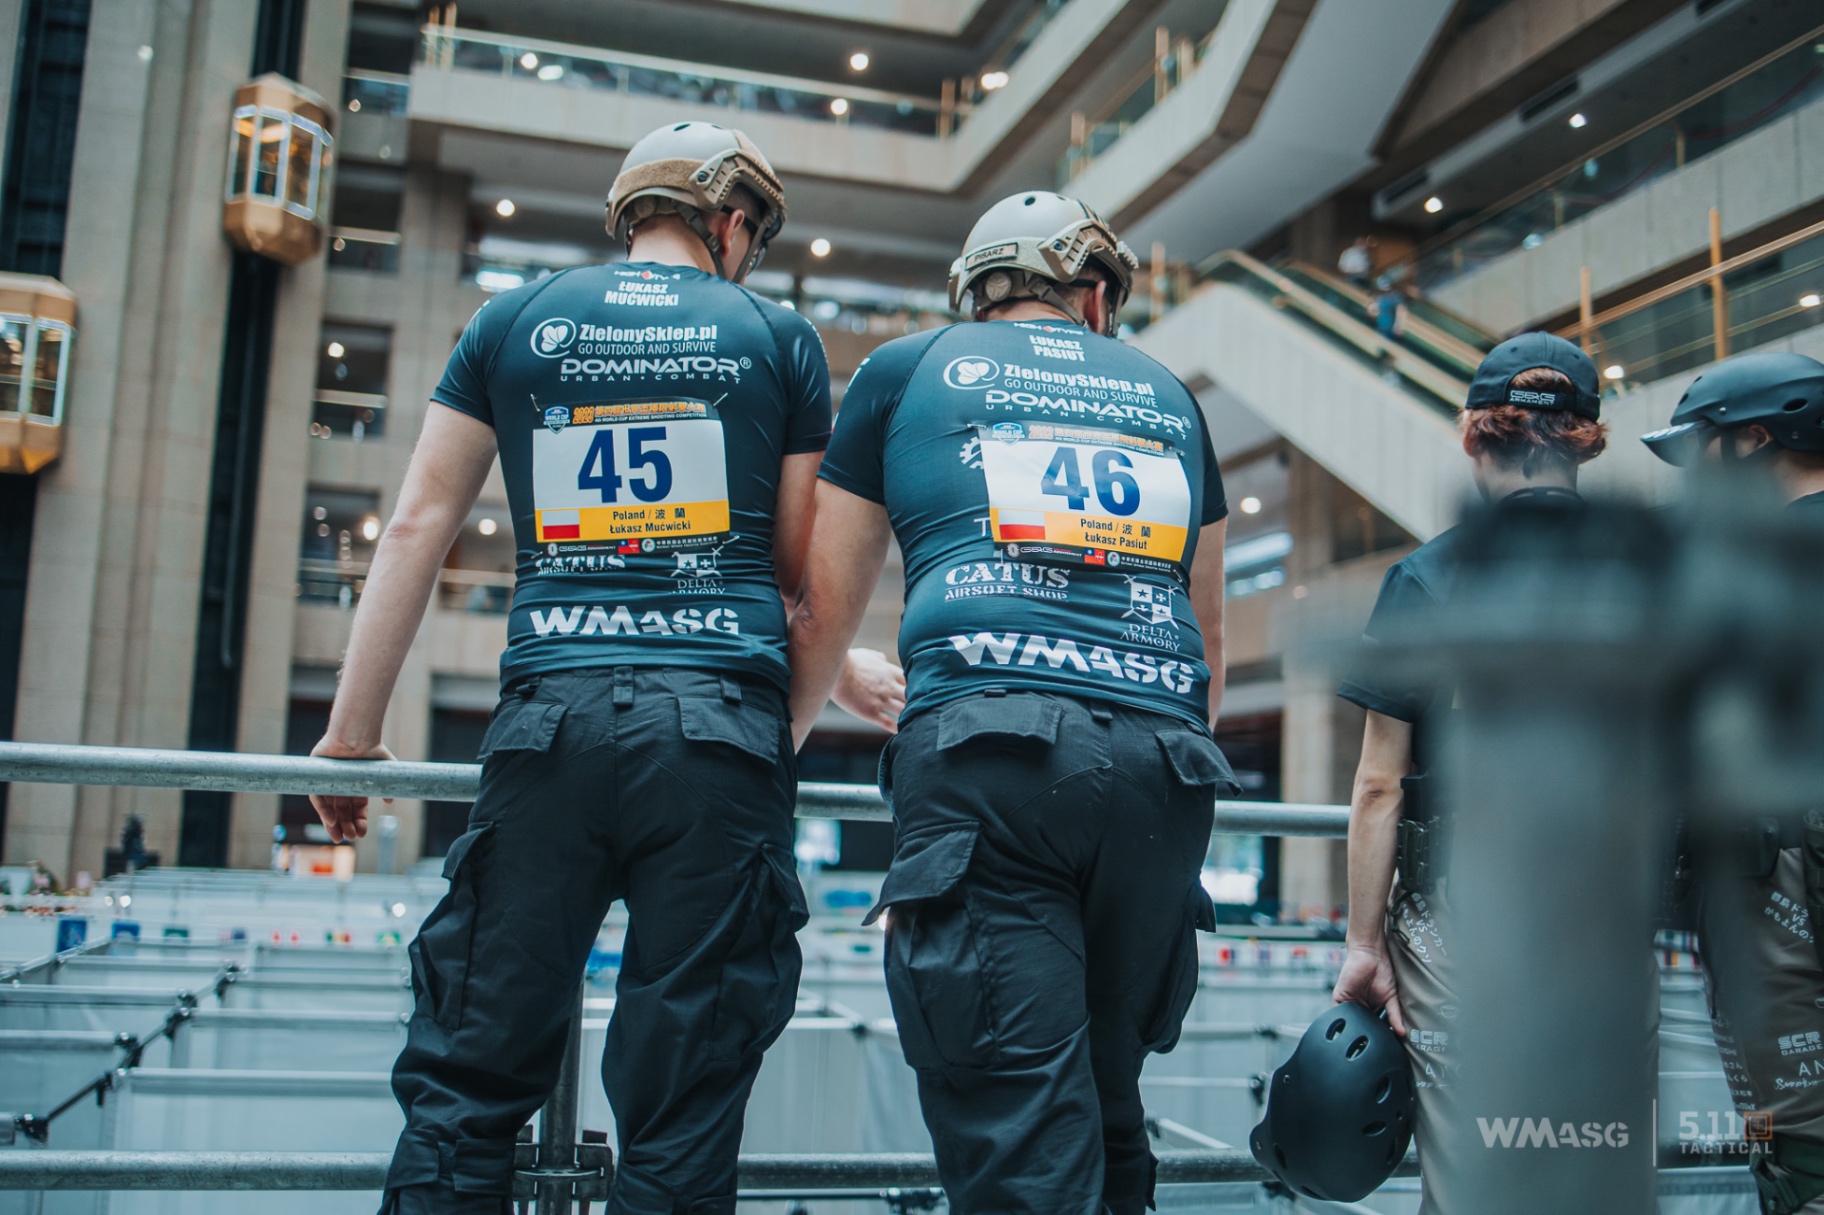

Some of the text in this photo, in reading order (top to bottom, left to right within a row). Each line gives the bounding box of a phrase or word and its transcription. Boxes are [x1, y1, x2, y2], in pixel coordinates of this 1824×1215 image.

[618, 280, 669, 294] ŁUKASZ
[604, 290, 680, 307] MUĆWICKI
[579, 323, 718, 344] ZielonySklep.pl
[577, 341, 717, 355] GO OUTDOOR AND SURVIVE
[1028, 334, 1083, 351] ŁUKASZ
[1033, 345, 1086, 362] PASIUT
[560, 372, 742, 385] URBAN COMBAT
[1003, 363, 1156, 397] ZielonySklep.pl
[1003, 378, 1159, 409] GO OUTDOOR AND SURVIVE
[985, 403, 1188, 441] URBAN COMBAT
[577, 426, 673, 504] 45
[1040, 446, 1141, 517] 46
[612, 509, 646, 521] Poland
[609, 520, 692, 534] Łukasz Mućwicki
[1080, 518, 1113, 532] Poland
[1084, 531, 1149, 551] Łukasz Pasiut
[676, 579, 718, 589] DELTA
[945, 562, 1071, 590] CATUS
[944, 584, 1018, 601] AIRSOFT
[529, 604, 739, 638] WMASG
[1128, 623, 1173, 638] DELTA
[1120, 631, 1181, 652] ARMORY
[947, 632, 1195, 694] WMASG
[1409, 1028, 1449, 1046] SCR
[1777, 1031, 1822, 1050] SCR
[1781, 1043, 1824, 1057] GARAGE
